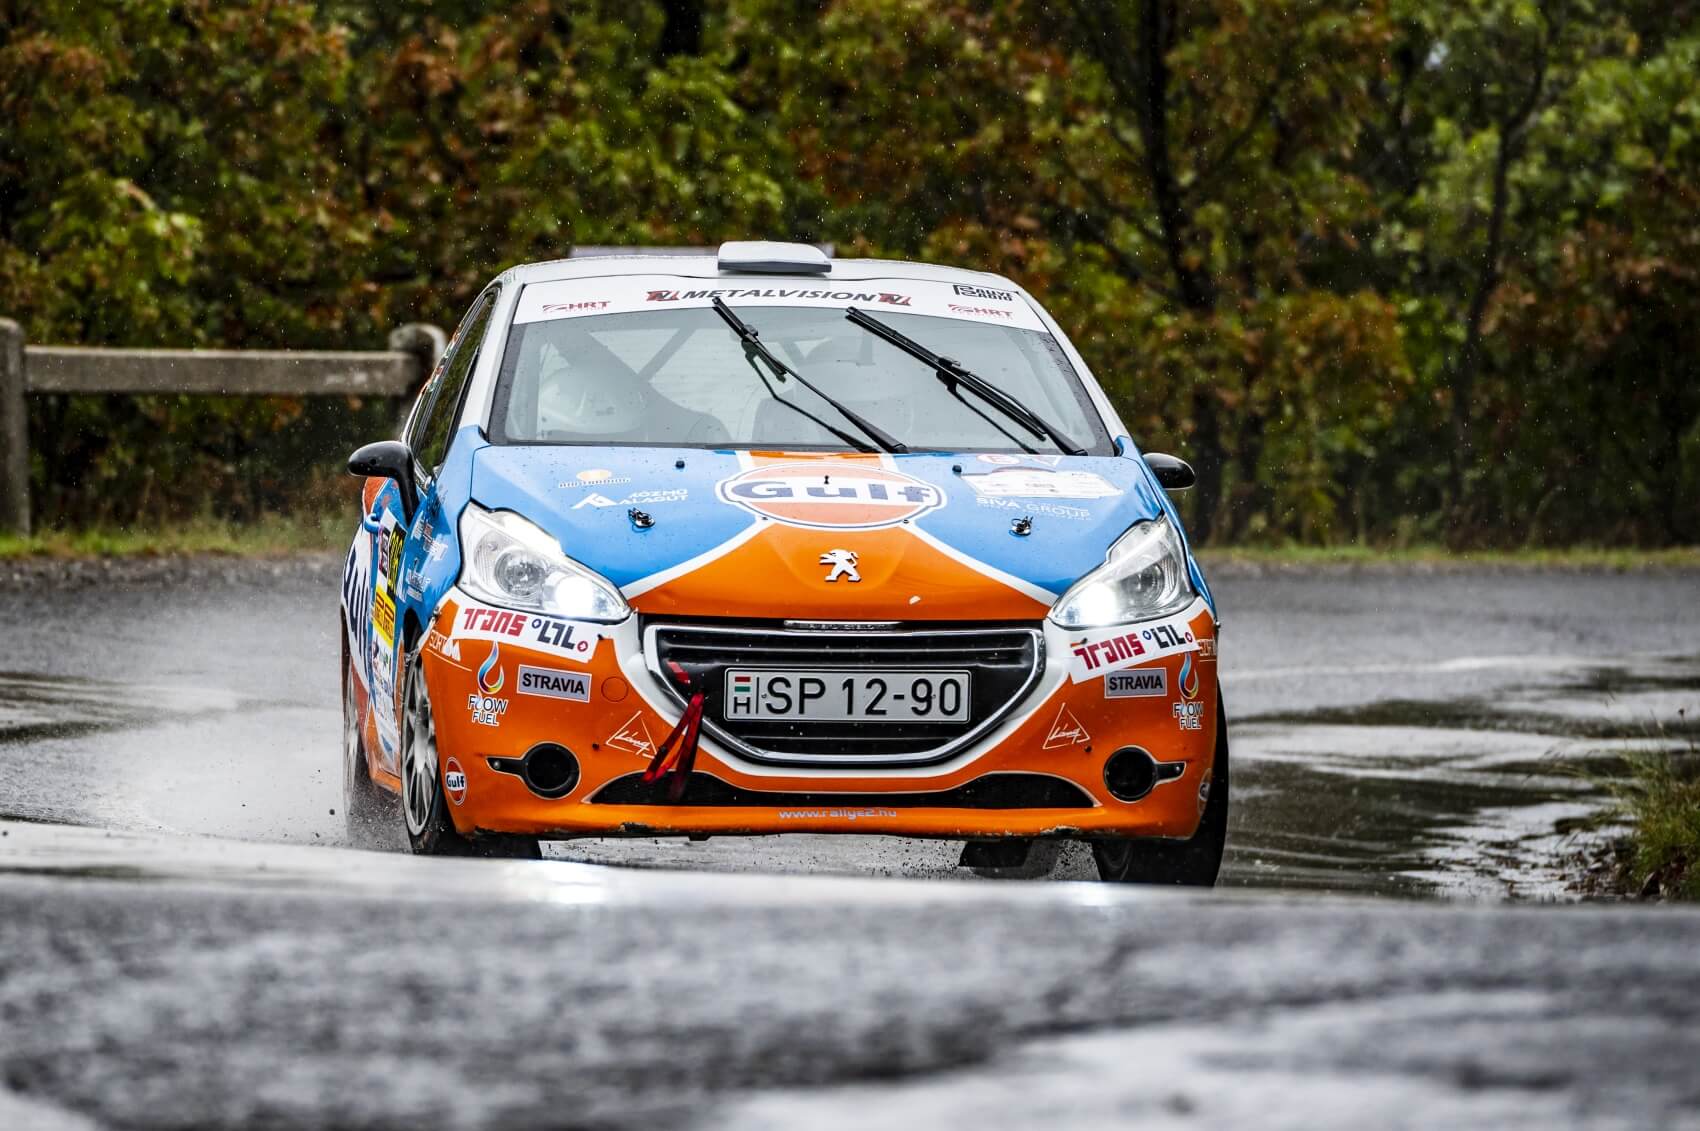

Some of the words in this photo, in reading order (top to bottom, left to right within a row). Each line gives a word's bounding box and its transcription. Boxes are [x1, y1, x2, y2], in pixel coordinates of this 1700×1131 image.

[682, 289, 877, 303] METALVISION
[569, 301, 612, 310] HRT
[974, 307, 1013, 317] HRT
[731, 479, 930, 502] Gulf
[522, 673, 585, 695] STRAVIA
[1108, 674, 1164, 691] STRAVIA
[733, 697, 751, 714] H
[765, 677, 826, 715] SP
[842, 678, 961, 716] 12-90
[468, 694, 508, 714] FLOW
[1172, 702, 1204, 718] FLOW
[471, 712, 500, 726] FUEL
[1179, 717, 1202, 730] FUEL
[446, 774, 465, 788] Gulf
[779, 809, 897, 820] www.rallye2.hu
